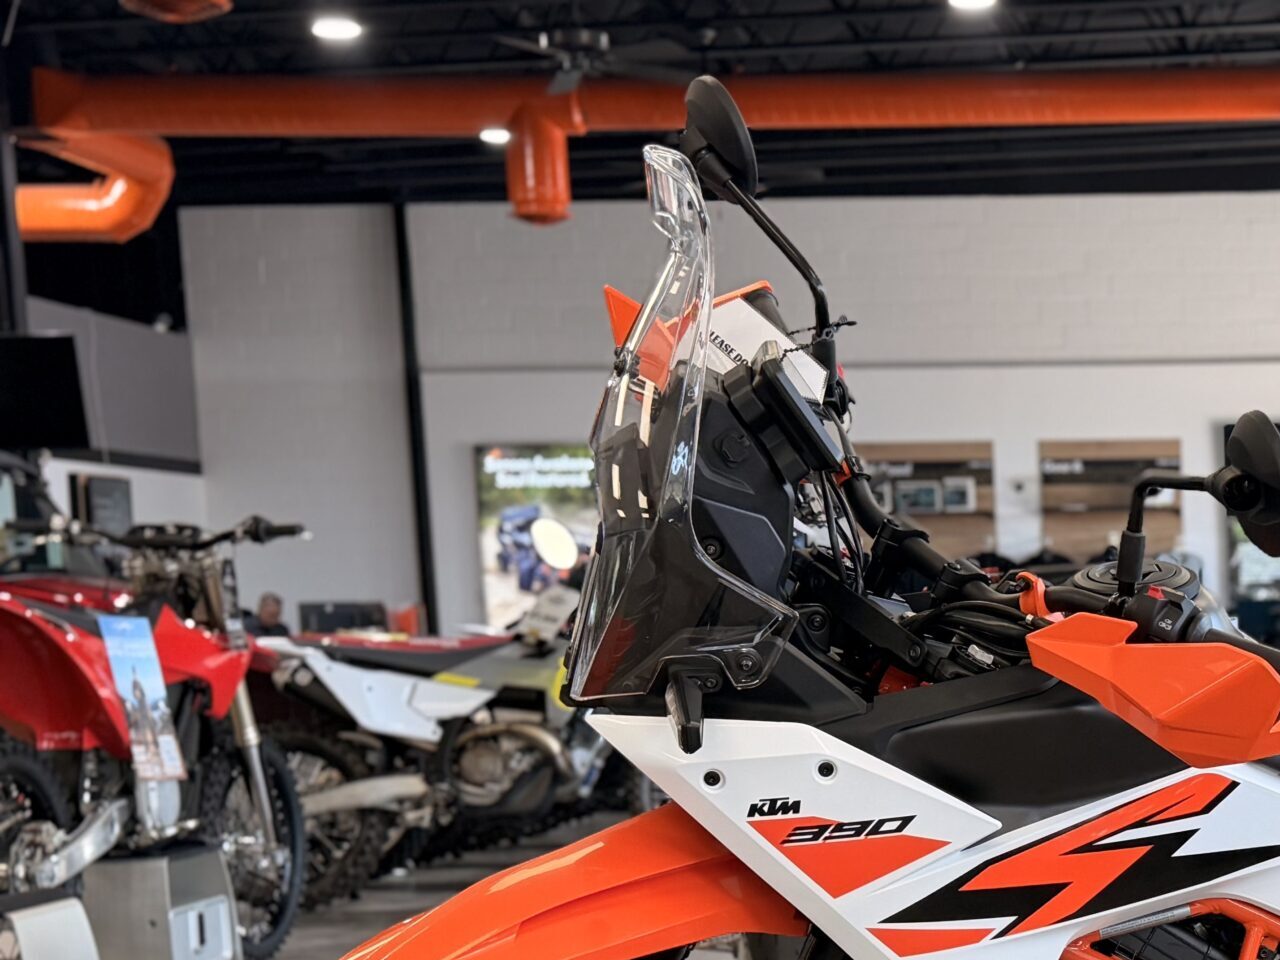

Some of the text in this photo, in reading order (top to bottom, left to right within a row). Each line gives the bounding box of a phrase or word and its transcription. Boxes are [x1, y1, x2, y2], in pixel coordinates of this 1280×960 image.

[709, 330, 737, 356] LEASE
[747, 797, 801, 817] KTM
[779, 815, 917, 845] 390
